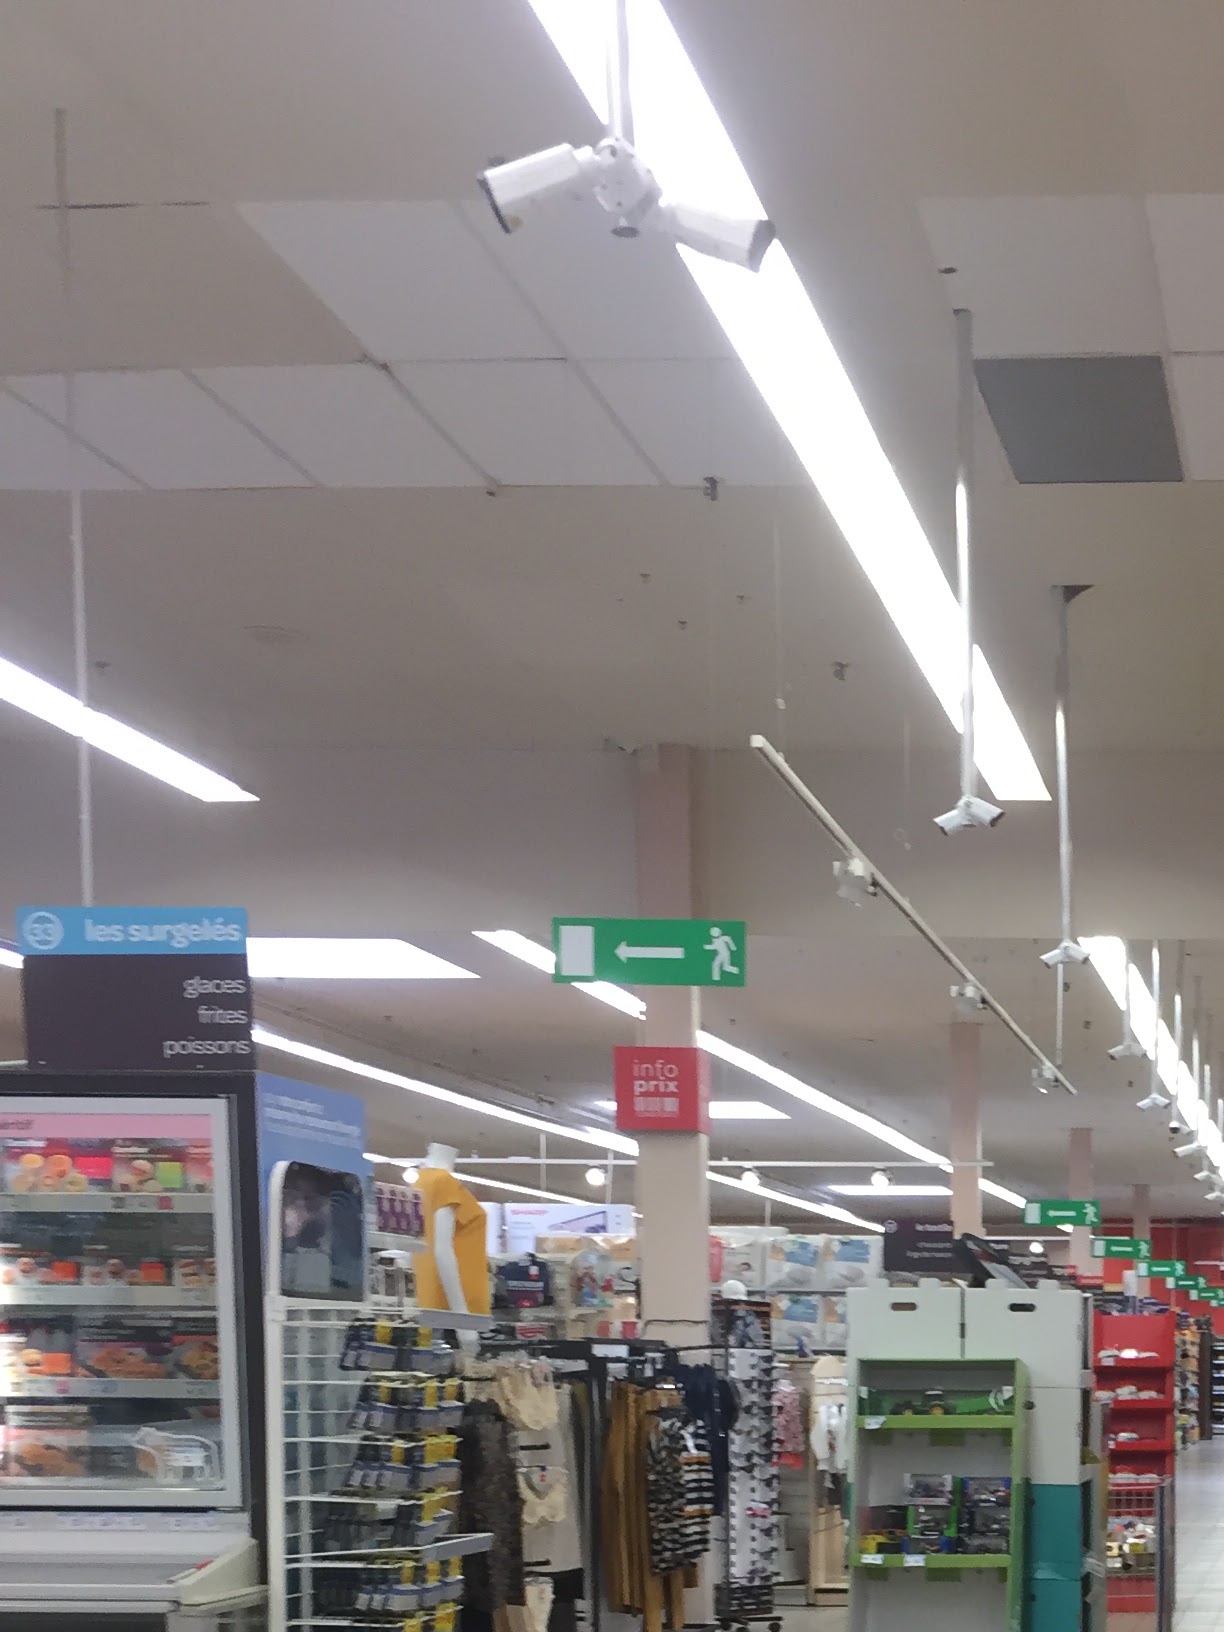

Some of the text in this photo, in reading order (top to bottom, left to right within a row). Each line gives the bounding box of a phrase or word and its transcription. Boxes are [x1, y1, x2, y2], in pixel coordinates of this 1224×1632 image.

[84, 917, 243, 948] les surgelés
[183, 975, 247, 999] glaces
[197, 1005, 248, 1024] frites
[162, 1036, 251, 1058] poissons
[632, 1059, 679, 1080] info
[633, 1080, 679, 1096] prix
